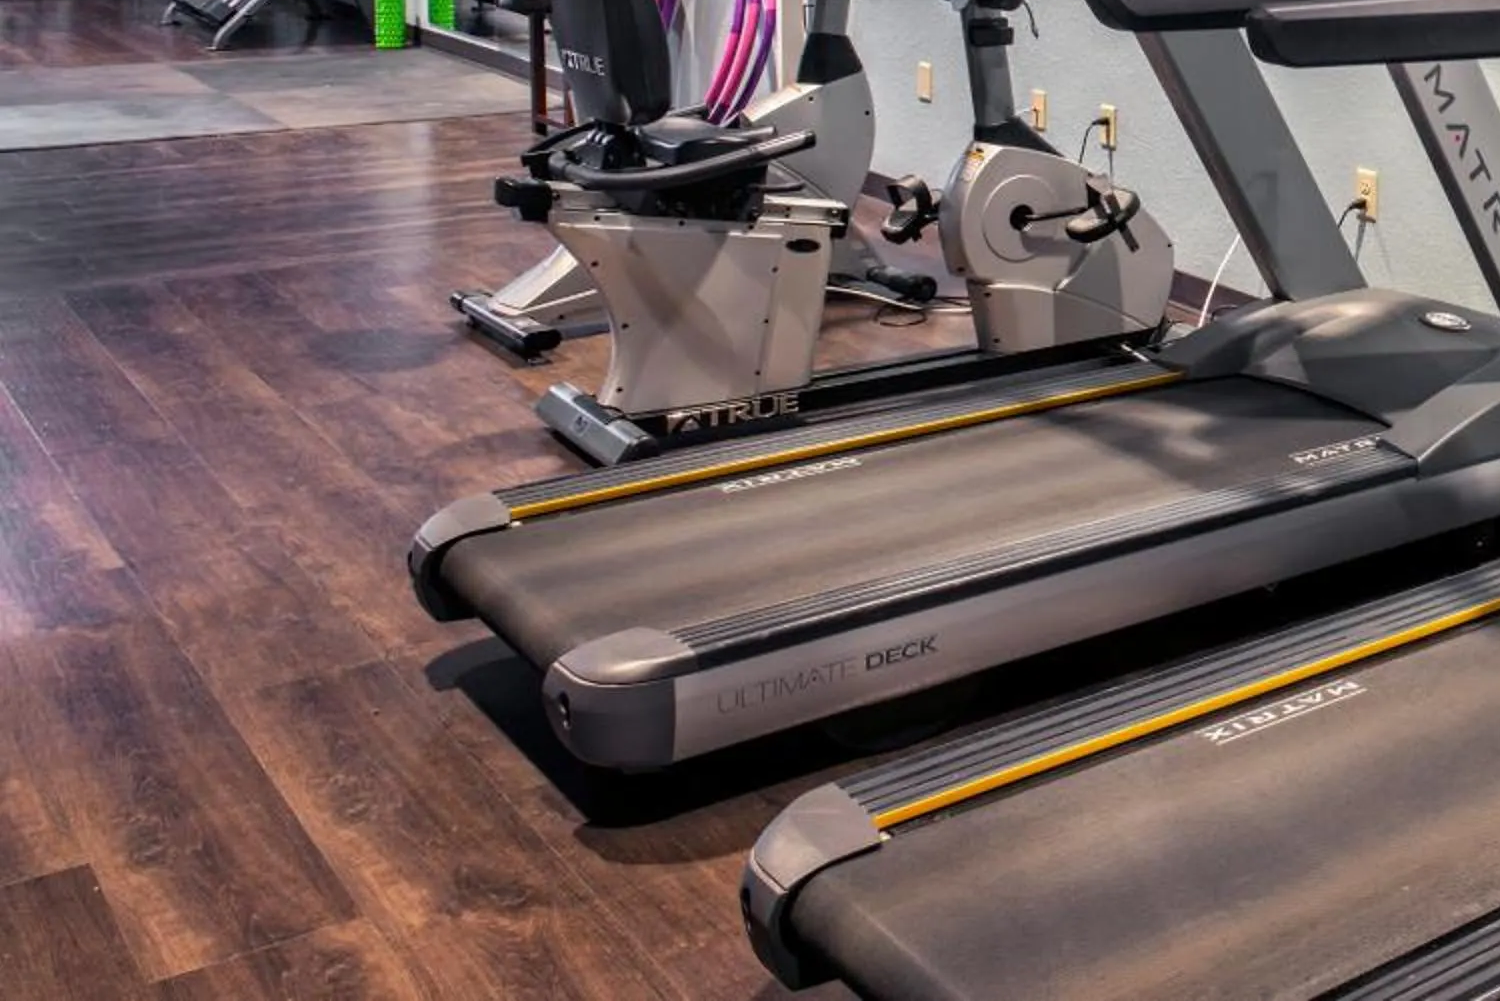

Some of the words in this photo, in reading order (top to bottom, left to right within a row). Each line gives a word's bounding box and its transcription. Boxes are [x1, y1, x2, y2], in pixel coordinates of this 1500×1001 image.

[704, 391, 800, 427] TRUE
[716, 655, 859, 715] ULTIMATE
[865, 633, 941, 672] DECK
